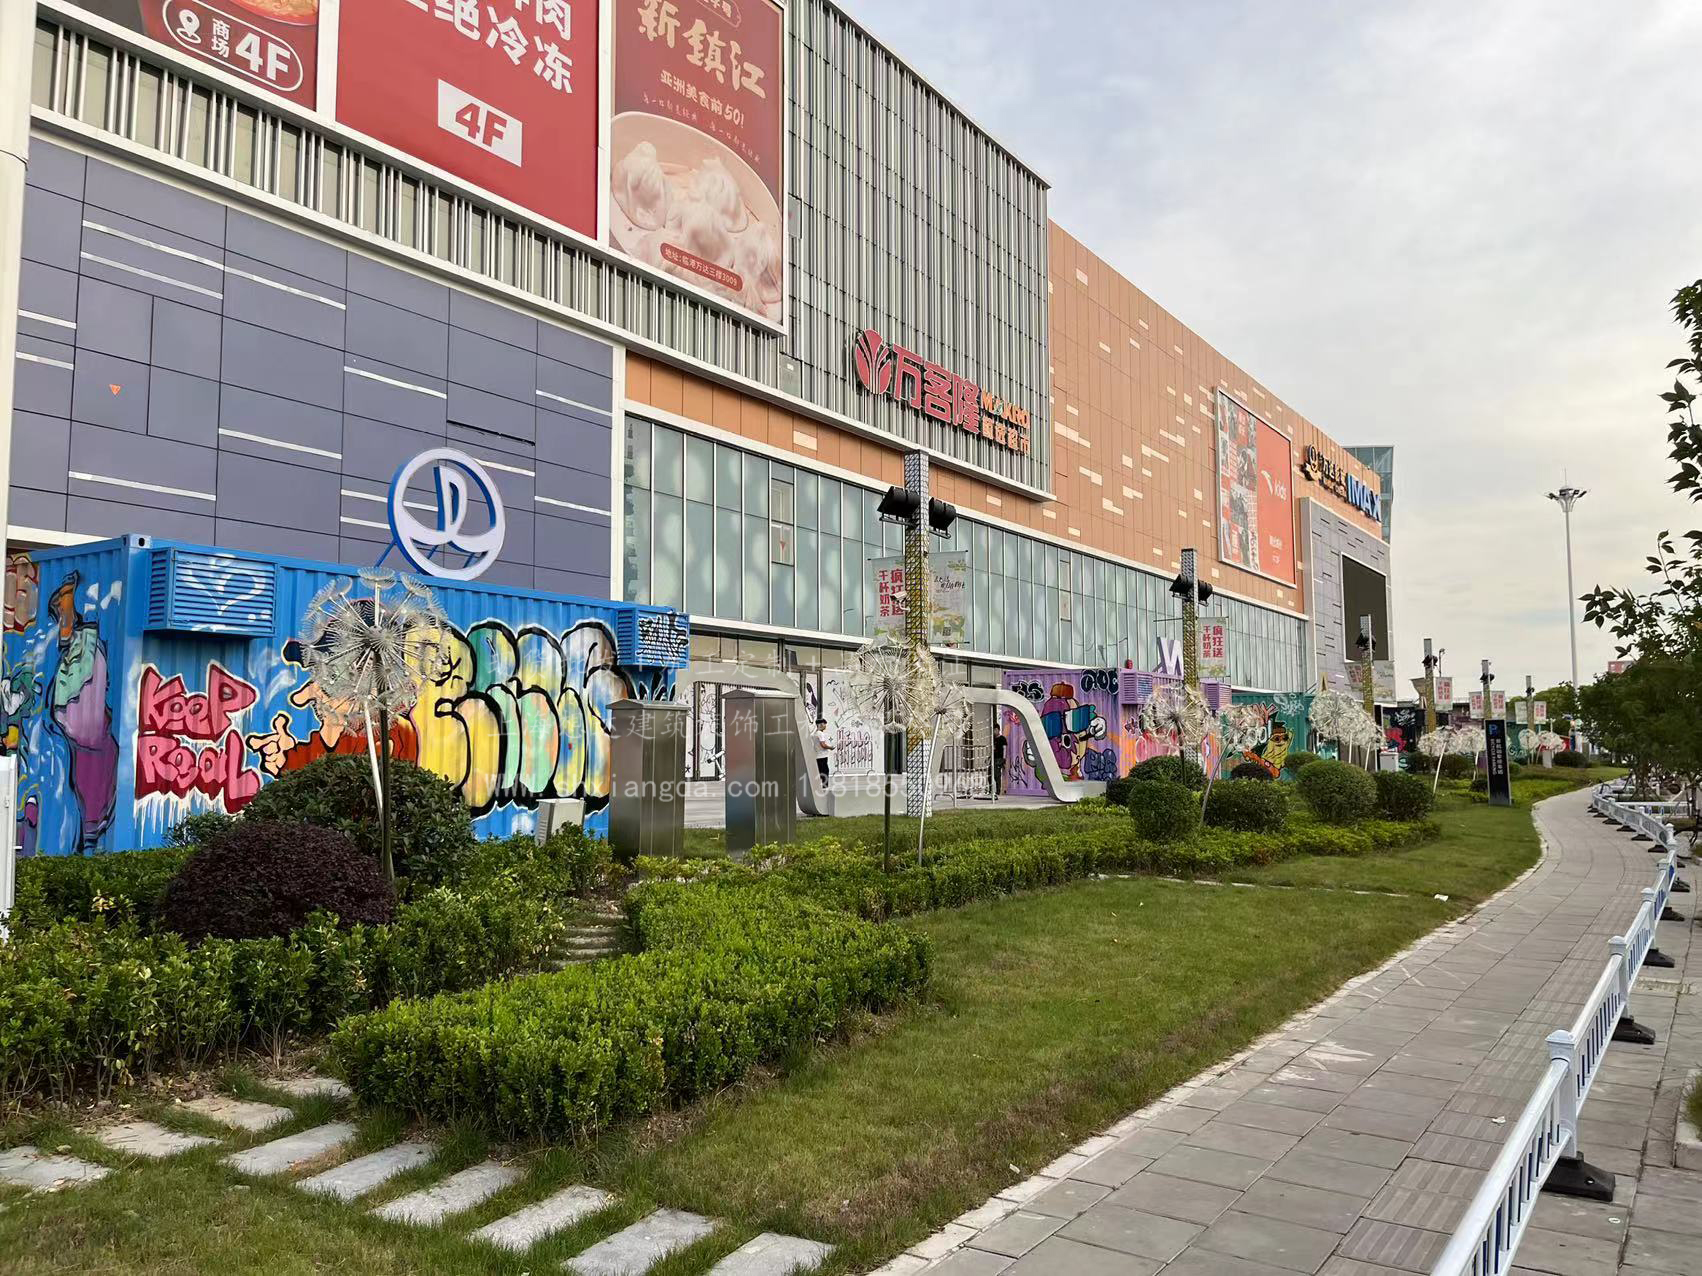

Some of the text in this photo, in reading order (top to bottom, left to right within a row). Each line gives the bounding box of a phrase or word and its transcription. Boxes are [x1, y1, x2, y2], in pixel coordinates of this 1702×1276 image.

[211, 17, 230, 58] 商场
[235, 32, 291, 82] 4F
[405, 0, 573, 94] 绝冷冻
[454, 102, 508, 148] 4F
[892, 343, 980, 435] 万客隆
[1346, 473, 1382, 522] IMAX
